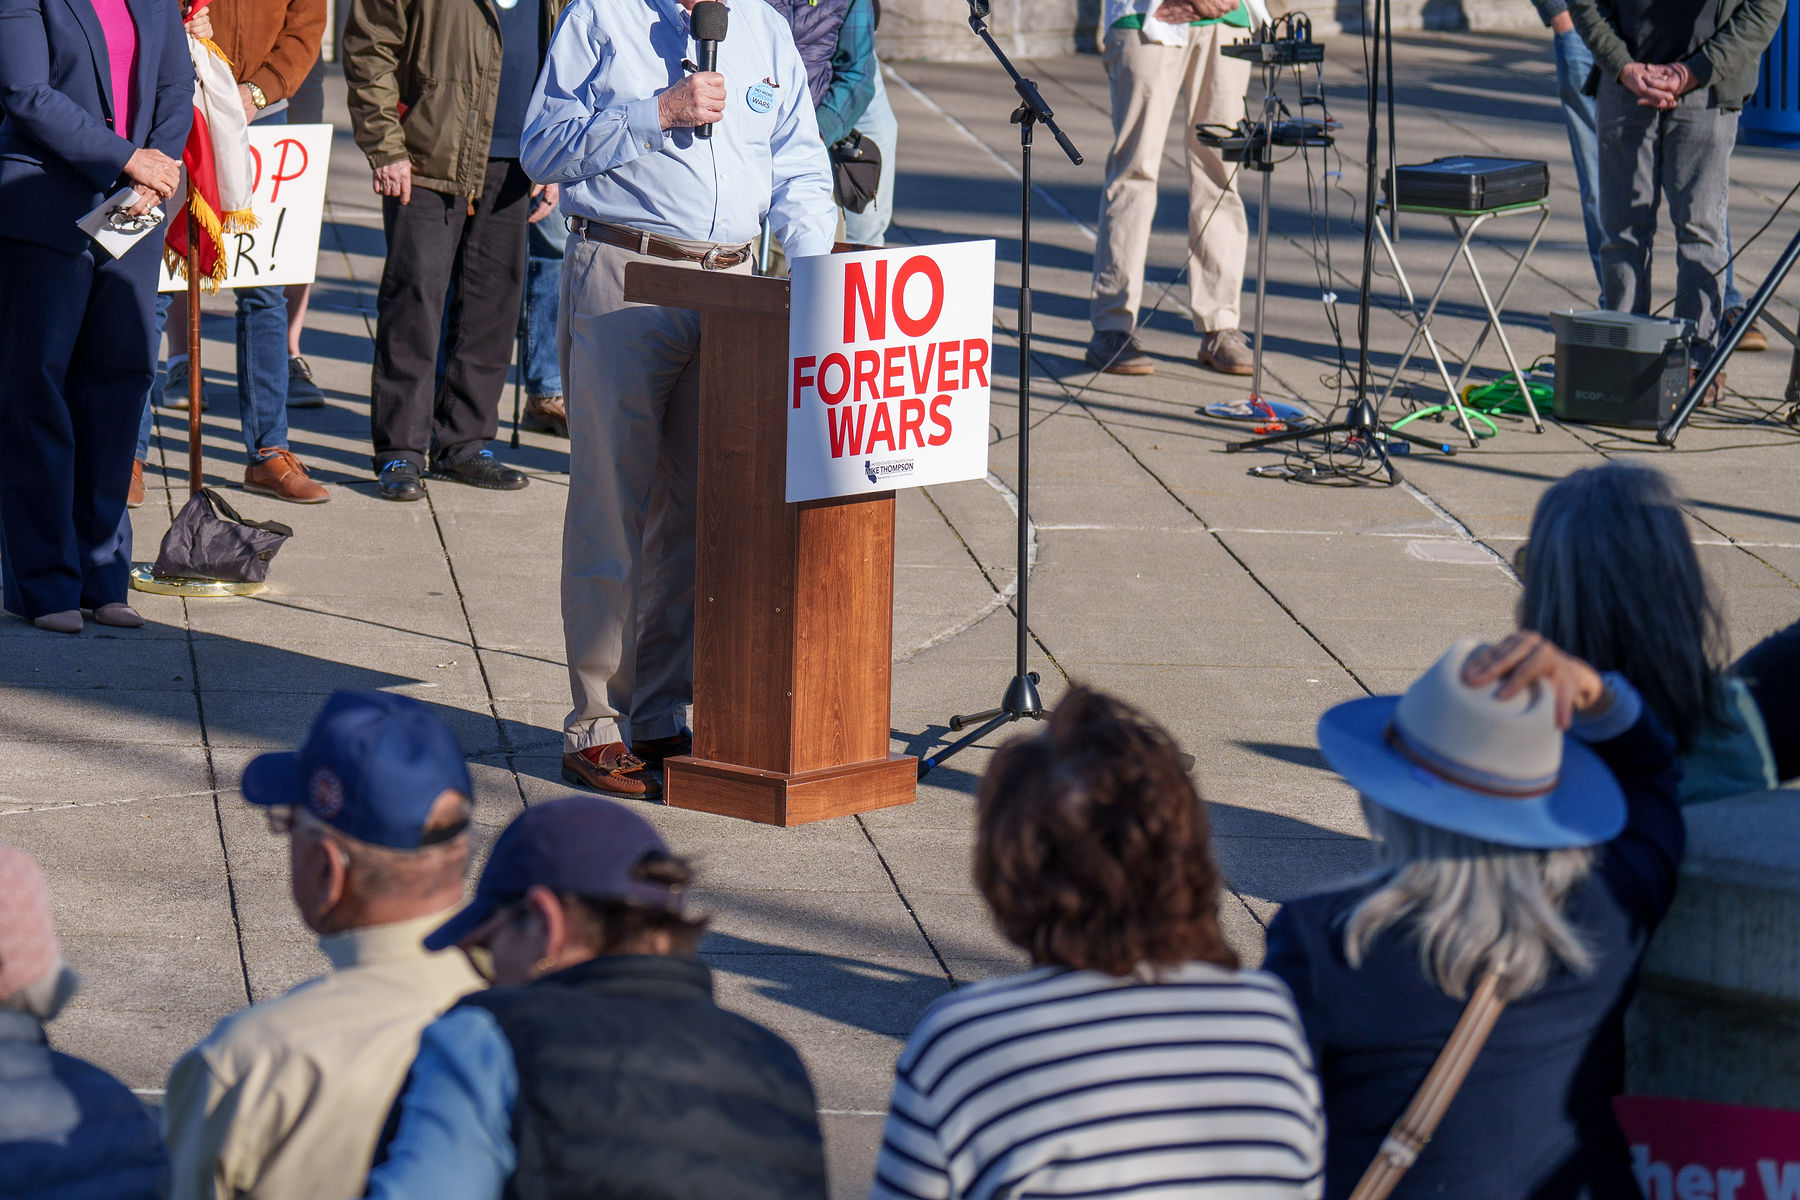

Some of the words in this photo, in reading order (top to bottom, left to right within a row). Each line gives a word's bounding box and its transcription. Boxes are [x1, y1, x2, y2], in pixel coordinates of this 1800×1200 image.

[842, 254, 945, 344] NO
[792, 337, 989, 409] FOREVER
[826, 393, 953, 459] WARS
[880, 462, 913, 473] THOMPSON
